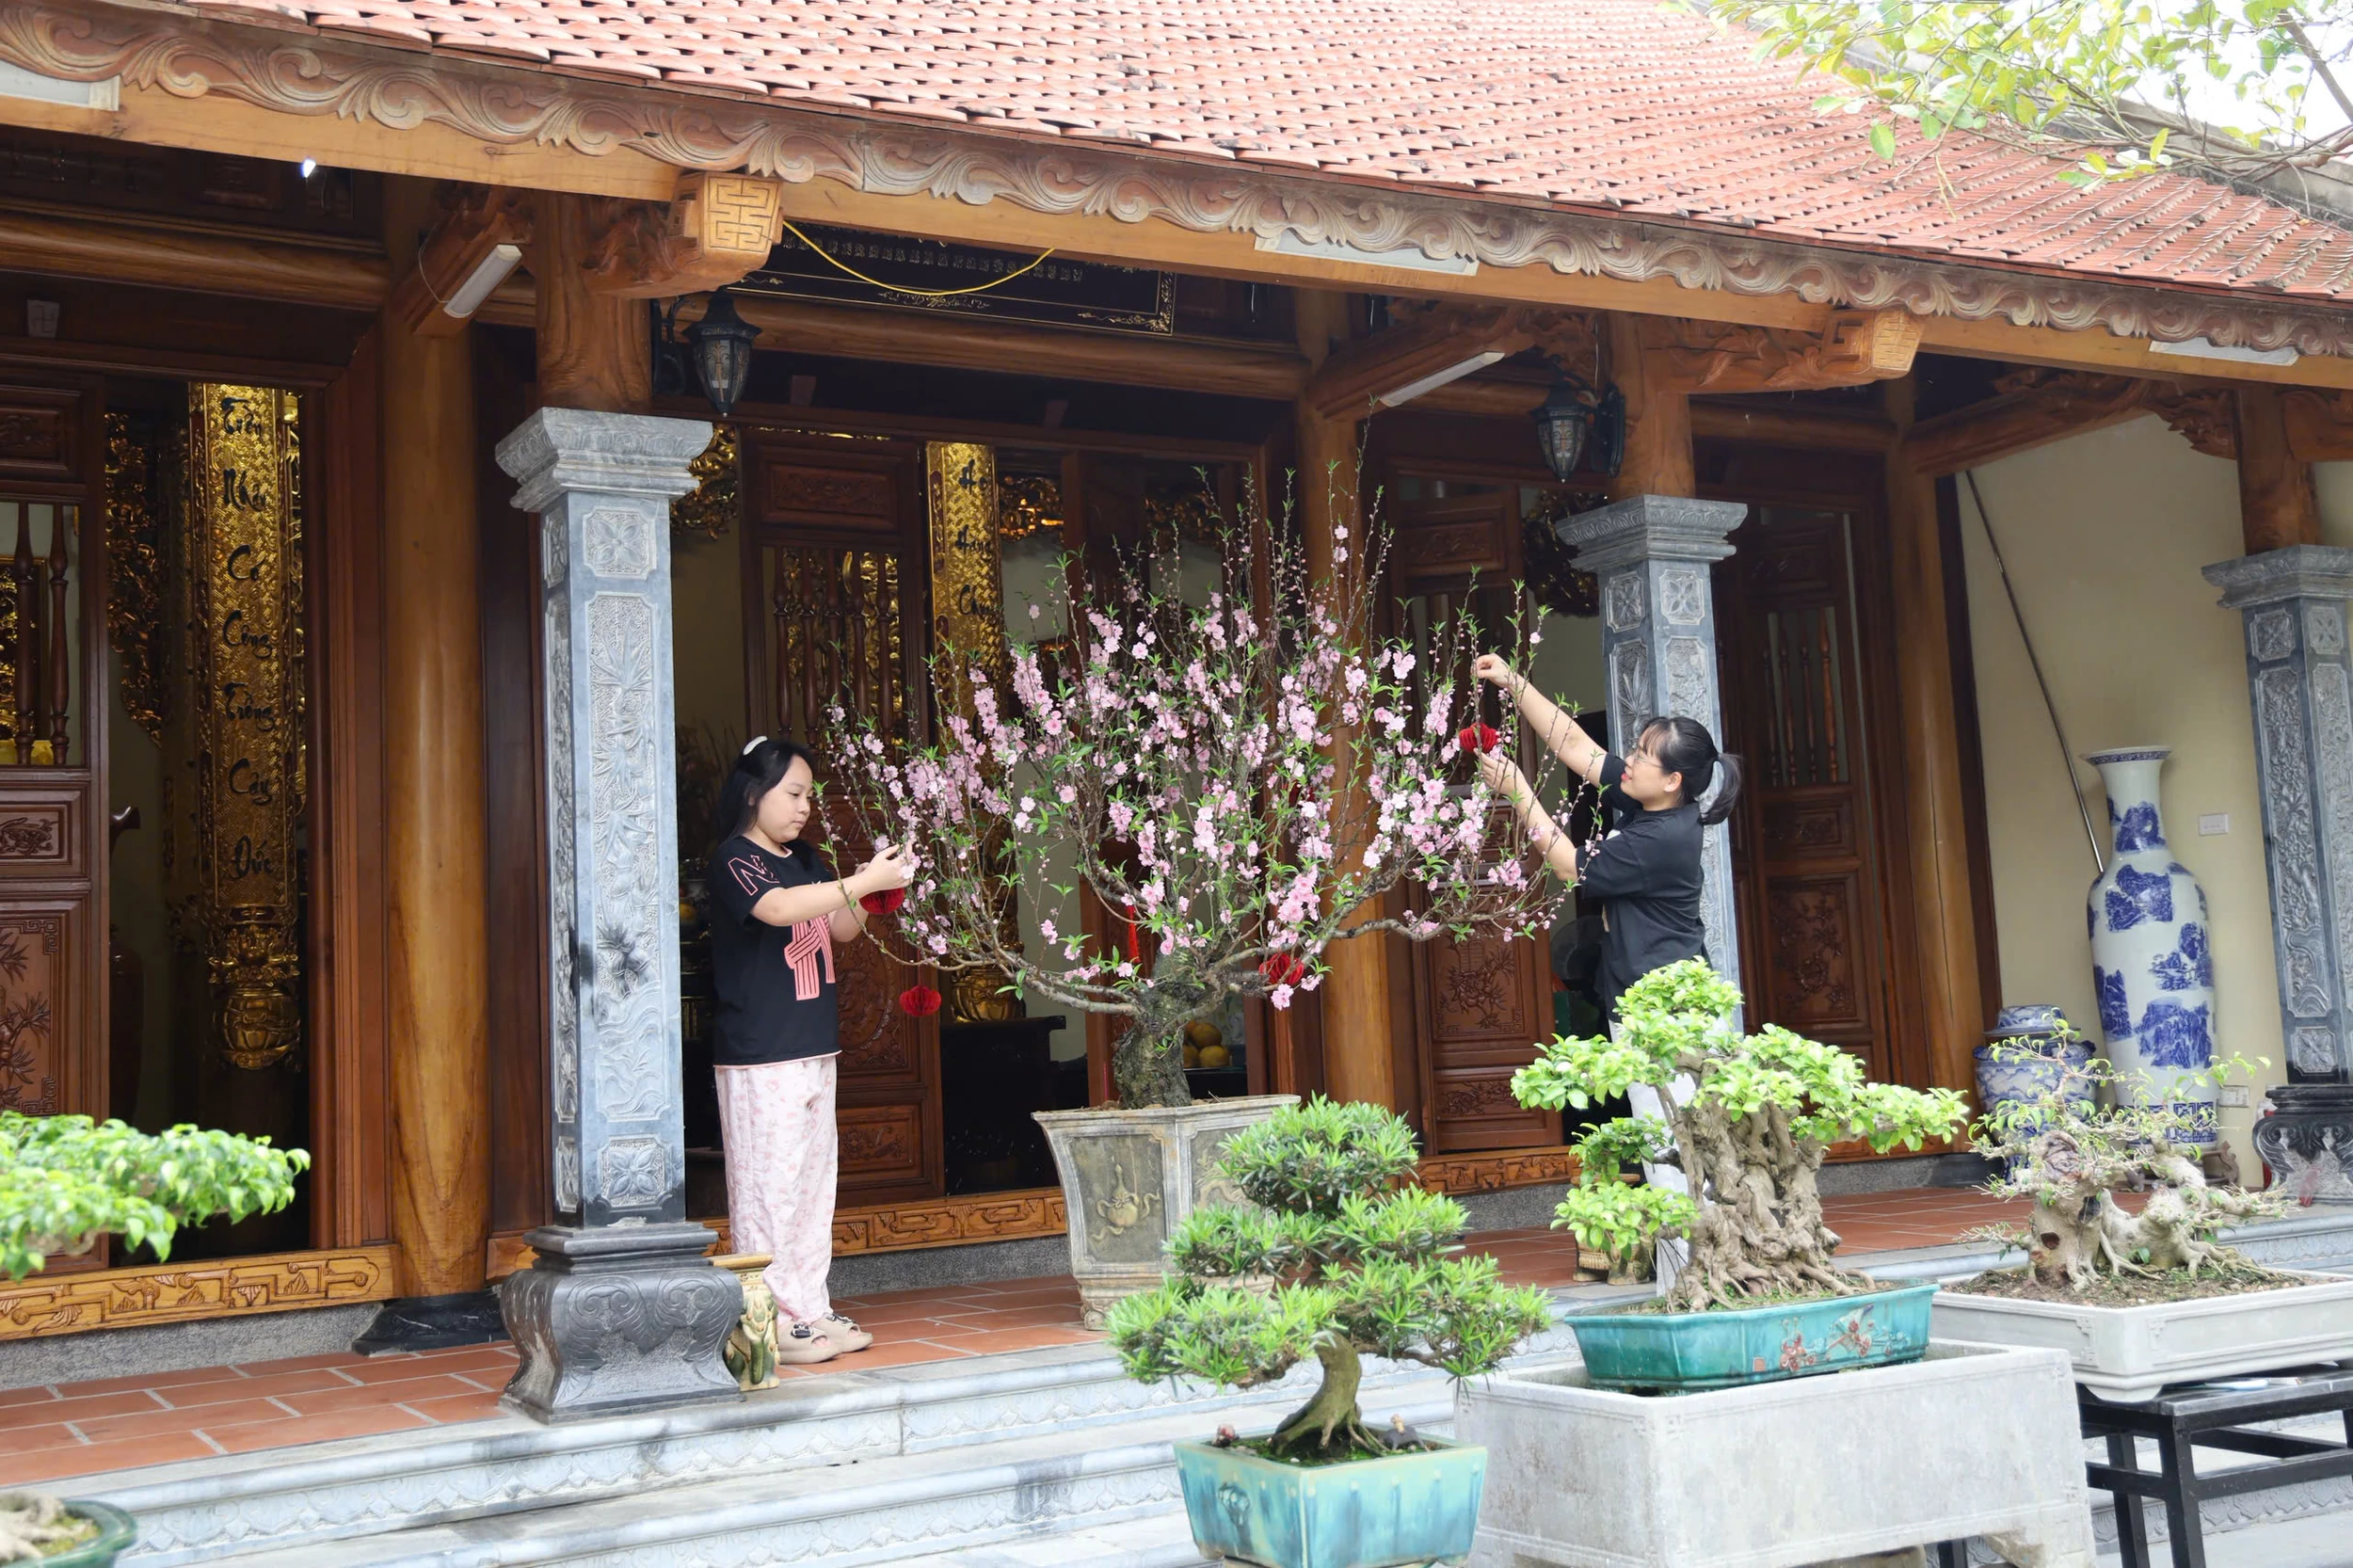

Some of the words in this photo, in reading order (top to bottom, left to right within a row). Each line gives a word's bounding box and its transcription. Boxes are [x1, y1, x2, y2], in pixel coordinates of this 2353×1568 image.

[223, 609, 272, 658] Công
[223, 681, 275, 731] Trồng
[229, 758, 273, 806] Cây
